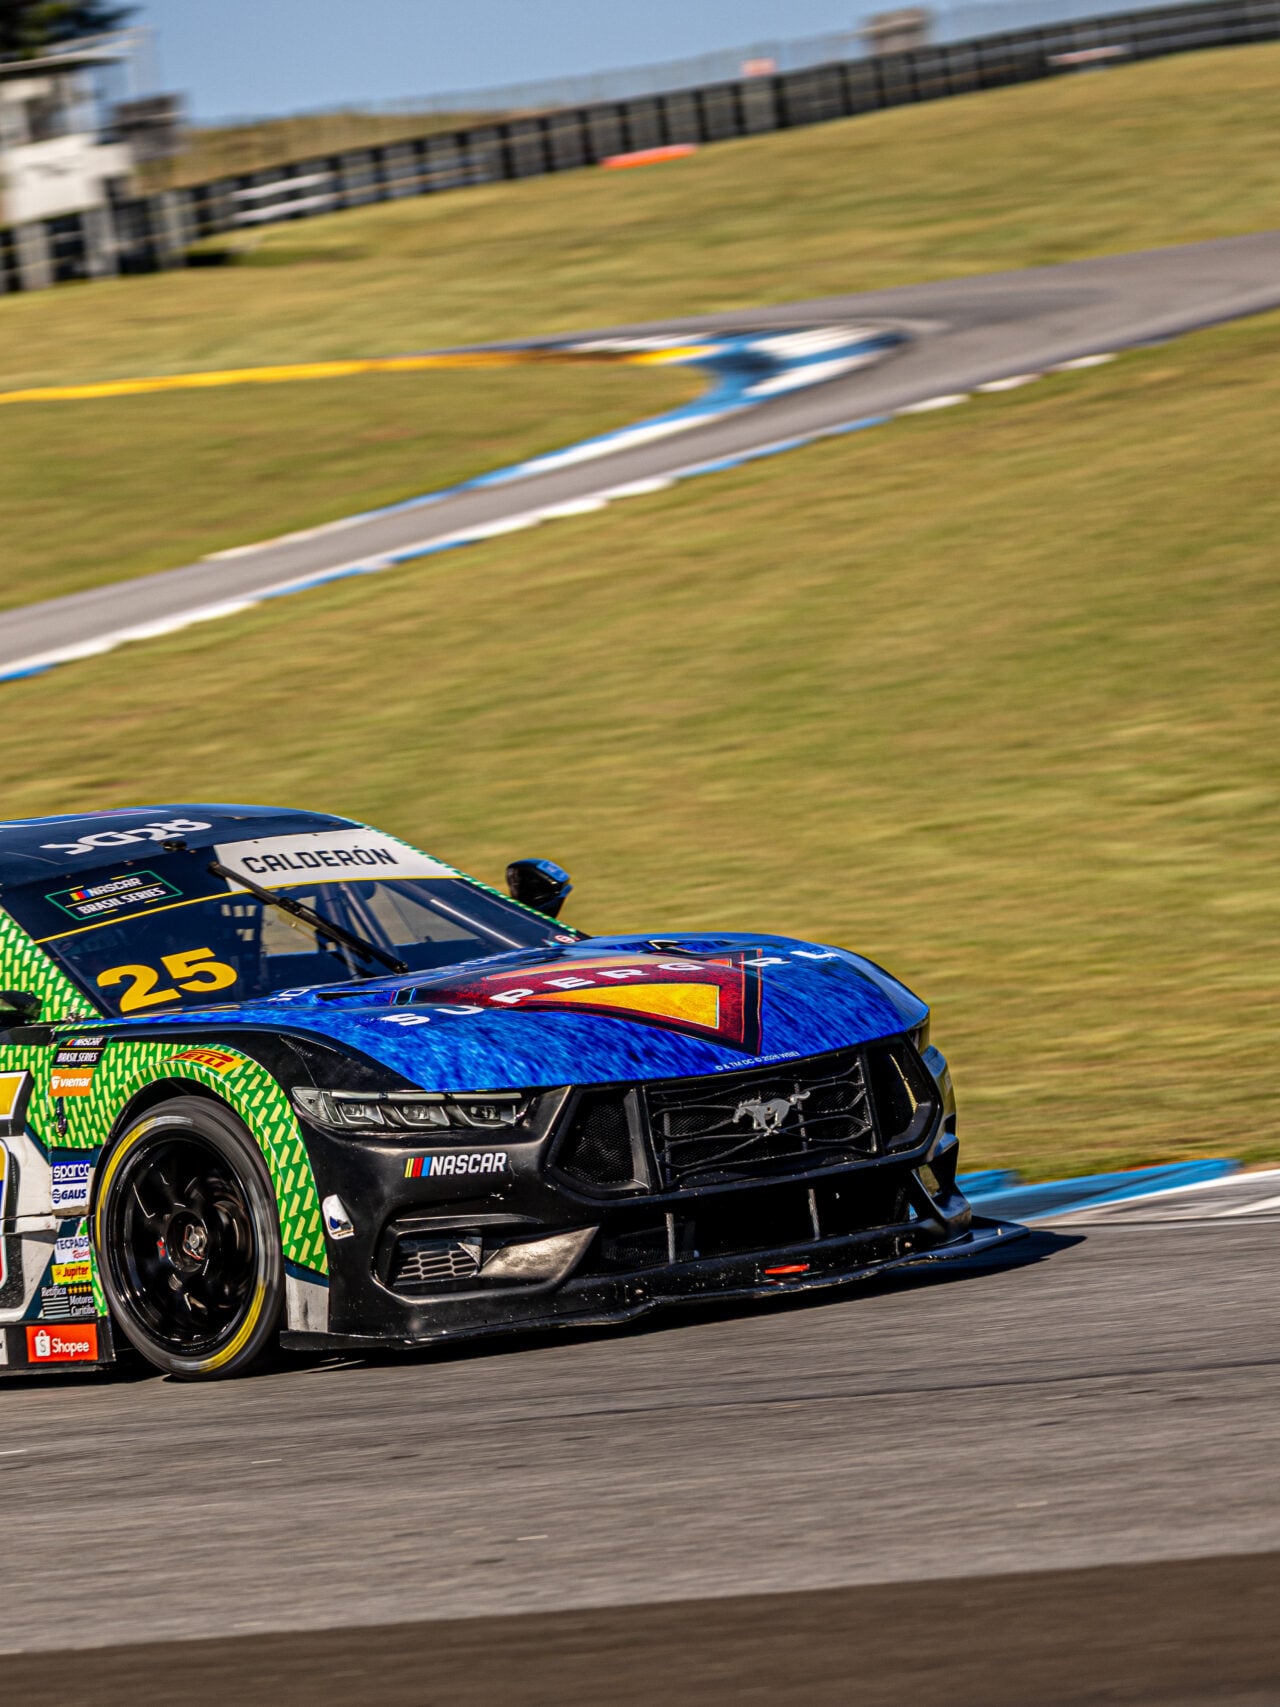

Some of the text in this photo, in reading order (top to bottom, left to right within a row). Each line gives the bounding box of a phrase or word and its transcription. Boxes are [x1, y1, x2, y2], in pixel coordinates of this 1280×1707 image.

[240, 844, 398, 874] CALDERÓN
[87, 878, 142, 896] NASCAR
[77, 887, 166, 914] BRASIL SERIES
[96, 947, 237, 1013] 25
[56, 1052, 99, 1063] BRASIL SERIES
[60, 1077, 91, 1088] viemar
[53, 1163, 90, 1182] sparco
[429, 1152, 508, 1177] NASCAR
[61, 1188, 87, 1200] GAUS
[56, 1237, 89, 1250] TECPADS
[63, 1266, 89, 1280] Jupiter
[51, 1338, 90, 1357] Shopee
